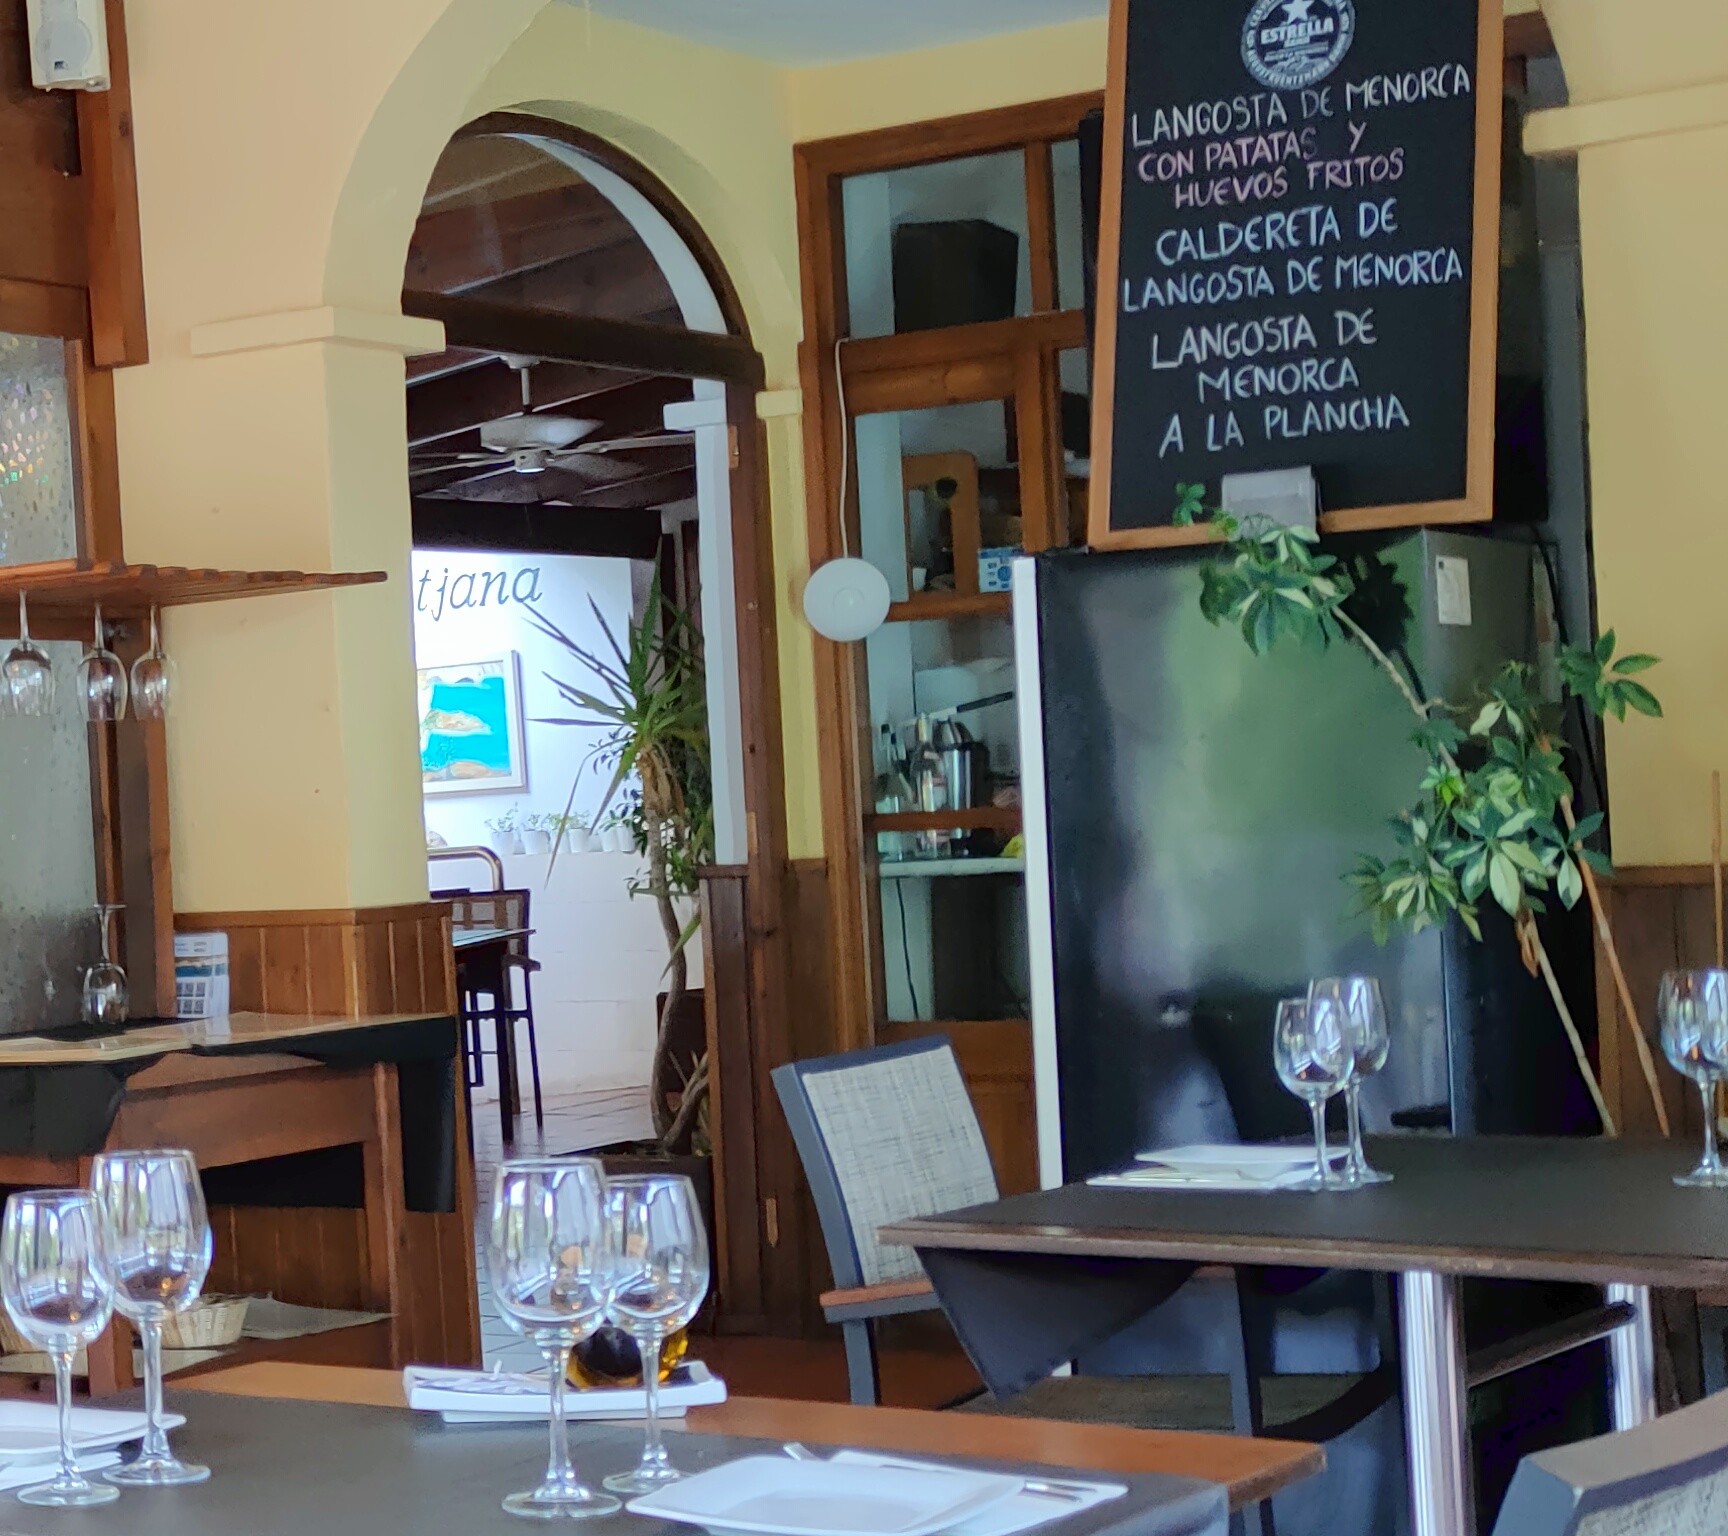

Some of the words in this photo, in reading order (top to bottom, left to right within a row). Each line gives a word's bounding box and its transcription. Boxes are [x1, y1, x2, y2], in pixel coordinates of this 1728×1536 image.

[1260, 16, 1334, 45] ESTRELLA
[1131, 92, 1288, 148] LANGOSTA
[1301, 86, 1334, 119] DE
[1345, 63, 1471, 112] MENORCA
[1138, 149, 1194, 182] CON
[1205, 127, 1317, 171] PATATAS
[1348, 120, 1367, 153] Y
[1175, 165, 1289, 209] HUEVOS
[1306, 147, 1405, 191] FRITOS
[1155, 205, 1342, 266] CALDERETA
[1359, 197, 1399, 239] DE
[1123, 264, 1275, 313] LANGOSTA
[1286, 256, 1323, 295] DE
[1335, 247, 1463, 290] MENORCA
[1152, 313, 1317, 369] LANGOSTA
[1334, 307, 1377, 346] DE
[1198, 356, 1359, 403] MENORCA
[1159, 414, 1184, 458] A
[1206, 411, 1244, 452] LA
[1264, 393, 1410, 440] PLANCHA
